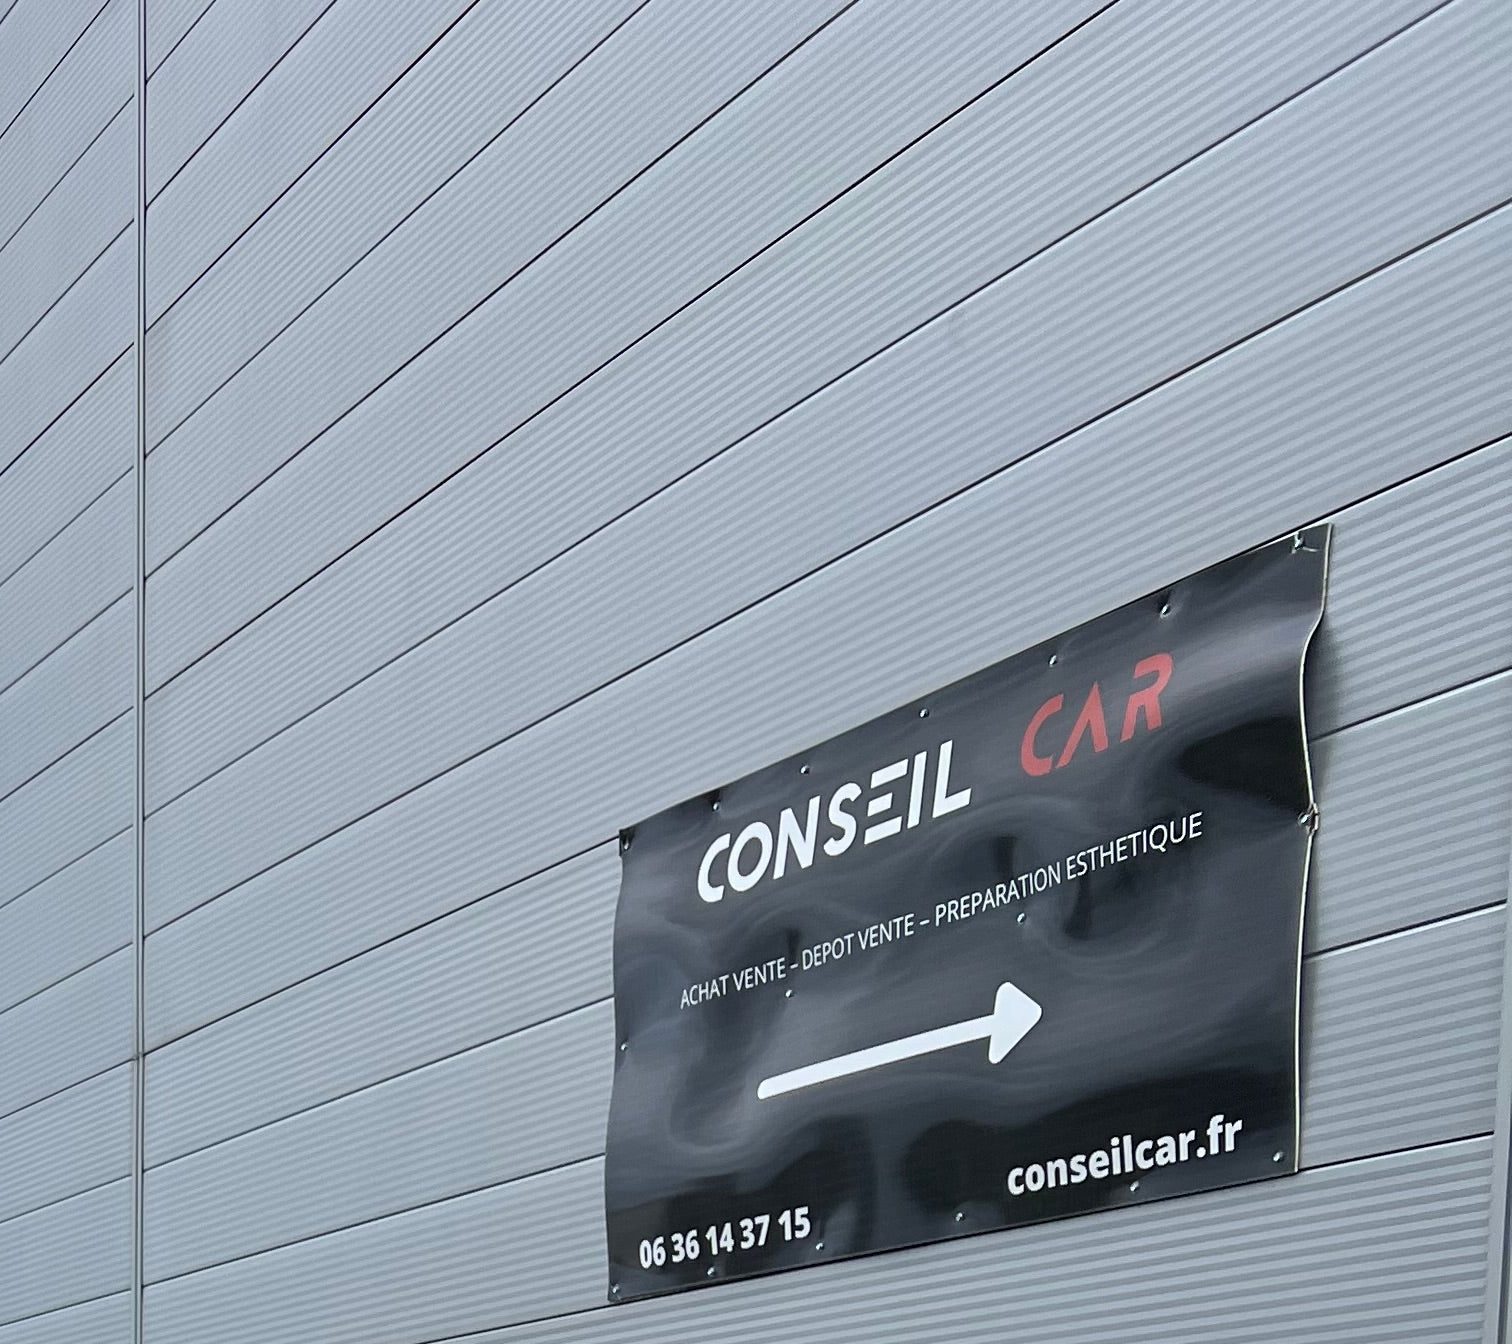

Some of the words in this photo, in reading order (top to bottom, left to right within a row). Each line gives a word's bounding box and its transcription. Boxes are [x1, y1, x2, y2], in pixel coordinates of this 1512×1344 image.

[697, 739, 972, 903] CONSEIL
[1021, 653, 1173, 777] CAR
[680, 974, 730, 1010] ACHAT
[733, 956, 787, 992] VENTE
[802, 932, 855, 971] DEPOT
[857, 913, 915, 951] VENTE
[934, 861, 1061, 928] PREPARATION
[1066, 810, 1204, 881] ESTHETIQUE
[1007, 1114, 1243, 1197] conseilcar.fr
[639, 1236, 667, 1270] 06
[670, 1228, 700, 1263] 36
[704, 1221, 735, 1257] 14
[739, 1213, 771, 1250] 37
[777, 1205, 811, 1242] 15
